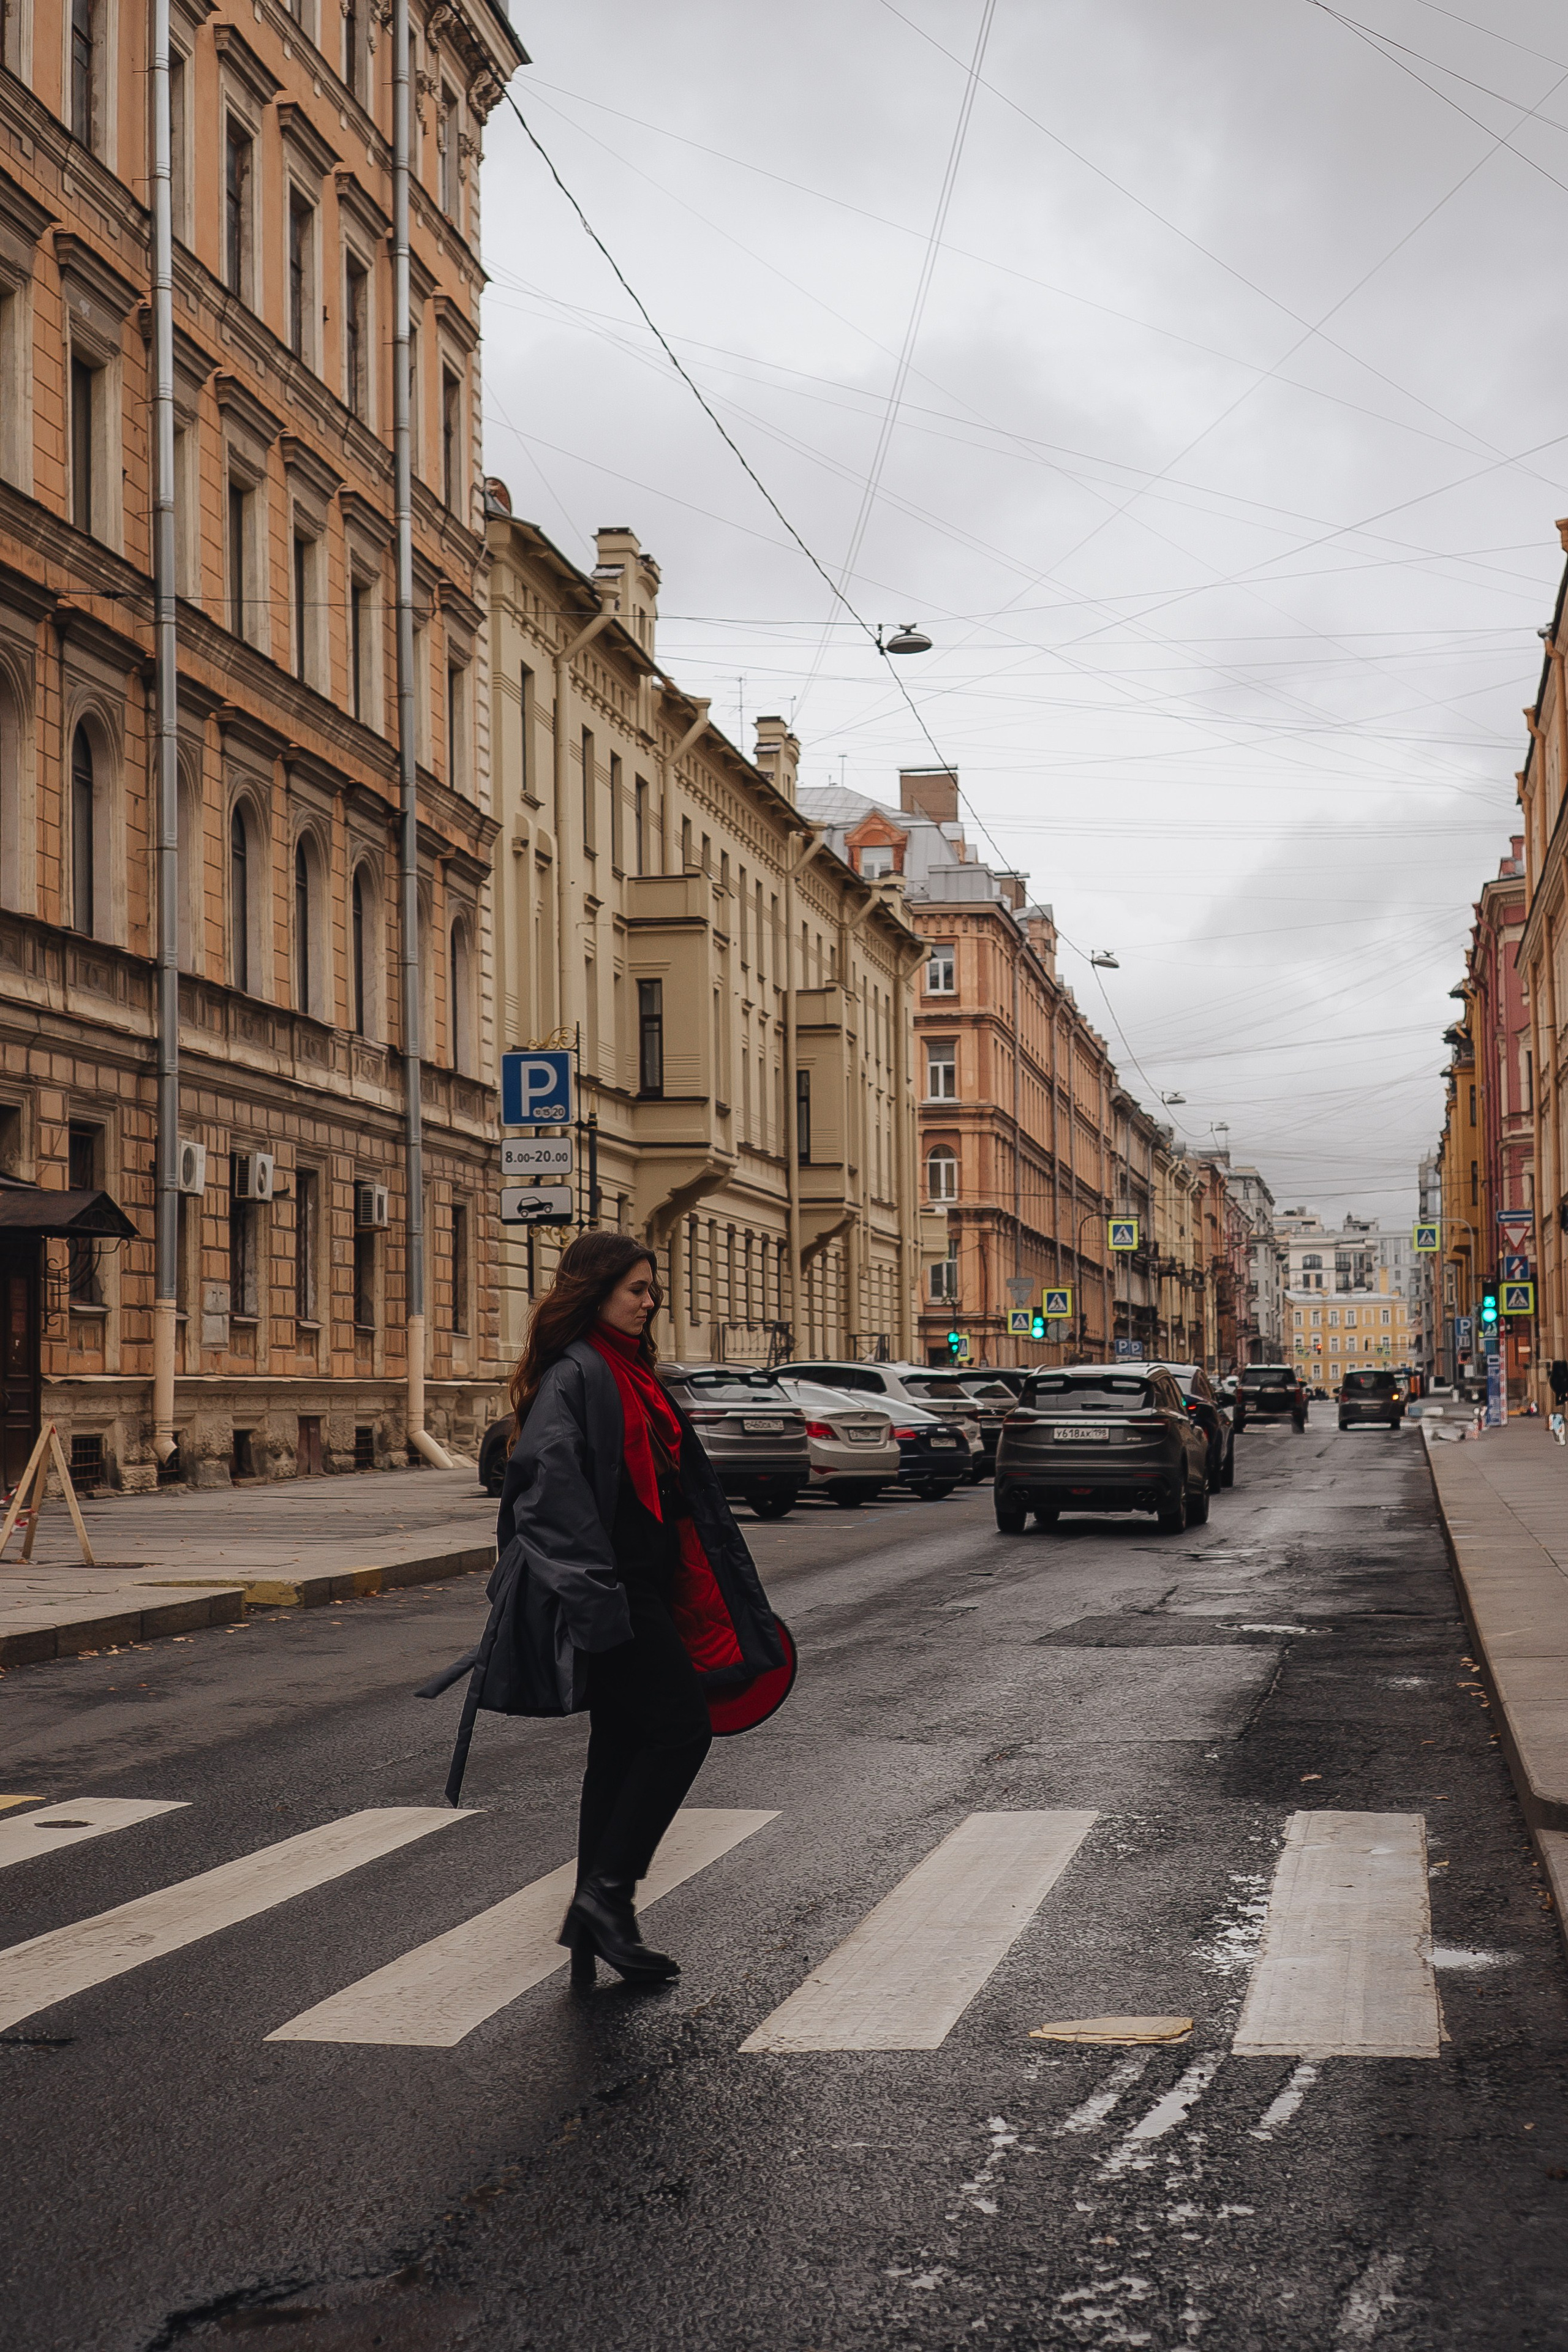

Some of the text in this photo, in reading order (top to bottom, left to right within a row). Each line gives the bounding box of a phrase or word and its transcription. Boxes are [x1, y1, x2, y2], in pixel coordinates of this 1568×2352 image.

[521, 1061, 557, 1117] P
[553, 1107, 564, 1117] 20
[505, 1150, 568, 1163] 8.00-20.00
[1460, 1319, 1471, 1335] P
[1119, 1340, 1128, 1352] P
